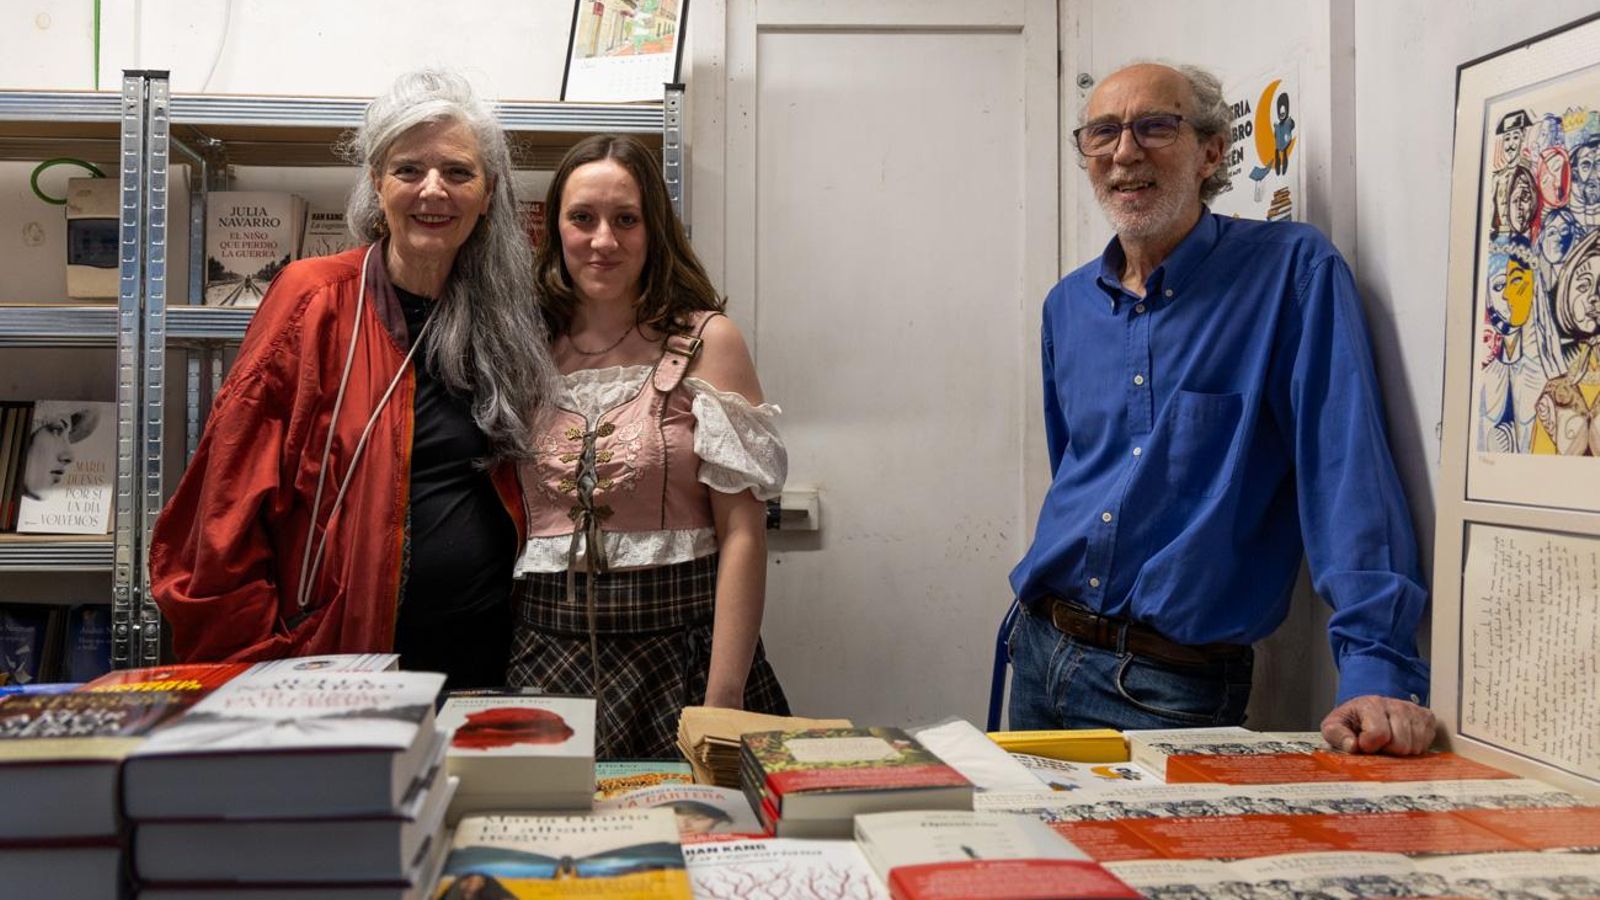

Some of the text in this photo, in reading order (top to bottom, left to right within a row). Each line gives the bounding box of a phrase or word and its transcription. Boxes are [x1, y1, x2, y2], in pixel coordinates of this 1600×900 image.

[1231, 100, 1251, 119] RIA
[230, 206, 268, 217] JULIA
[218, 217, 281, 228] NAVARRO
[229, 230, 268, 240] EL NIÑO
[219, 241, 240, 250] QUE
[235, 250, 276, 258] GUERRA
[40, 513, 98, 527] VOLVEMOS
[685, 843, 767, 857] HAN KANG
